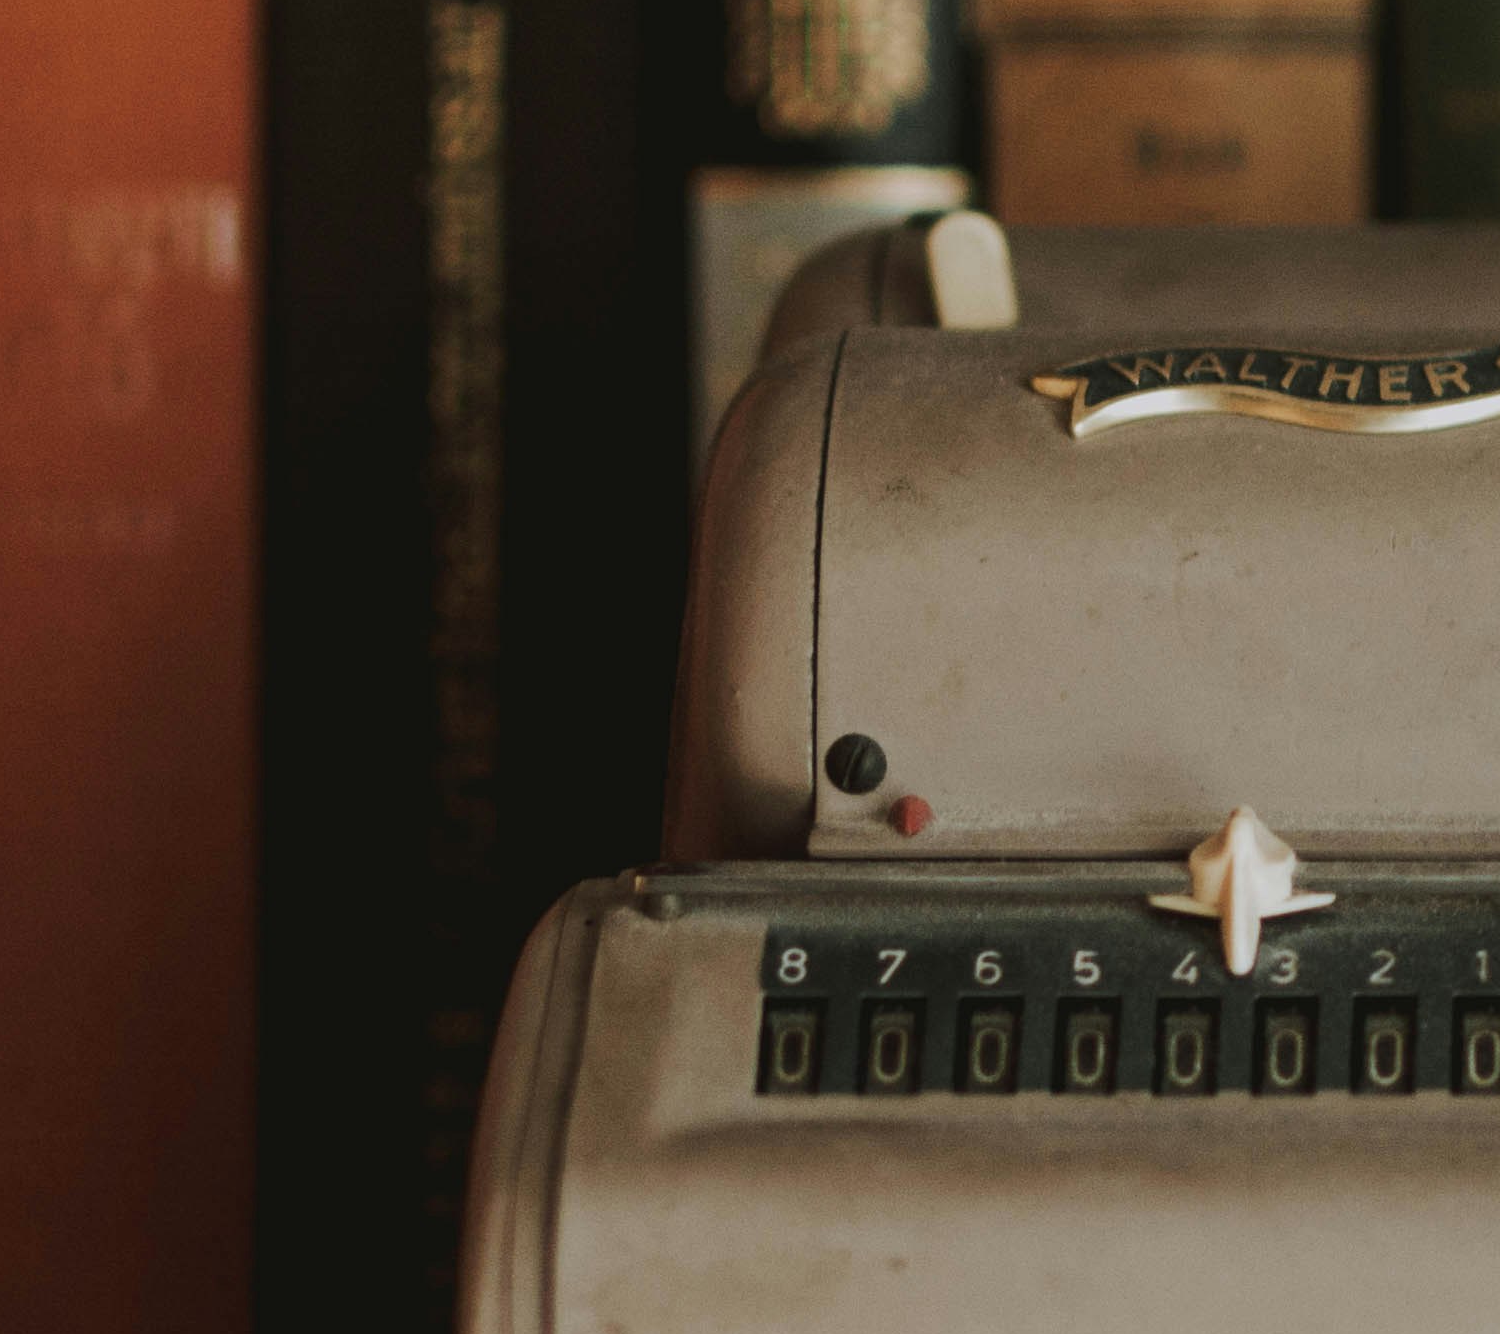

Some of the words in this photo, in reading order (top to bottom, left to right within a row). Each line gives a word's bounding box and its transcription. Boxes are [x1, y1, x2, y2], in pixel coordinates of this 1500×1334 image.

[1108, 351, 1471, 402] WALTHER
[777, 947, 808, 984] 8
[878, 948, 907, 985] 7
[974, 949, 1002, 985] 6
[1073, 949, 1101, 986] 5
[1171, 950, 1199, 984] 4
[1269, 949, 1299, 984] 3
[1368, 948, 1396, 985] 2
[1475, 949, 1488, 982] 1
[774, 1025, 811, 1087] 0
[871, 1026, 908, 1087] 0
[971, 1026, 1008, 1085] 0
[1070, 1031, 1106, 1088] 0
[1167, 1030, 1203, 1088] 0
[1268, 1027, 1304, 1088] 0
[1367, 1028, 1403, 1088] 0
